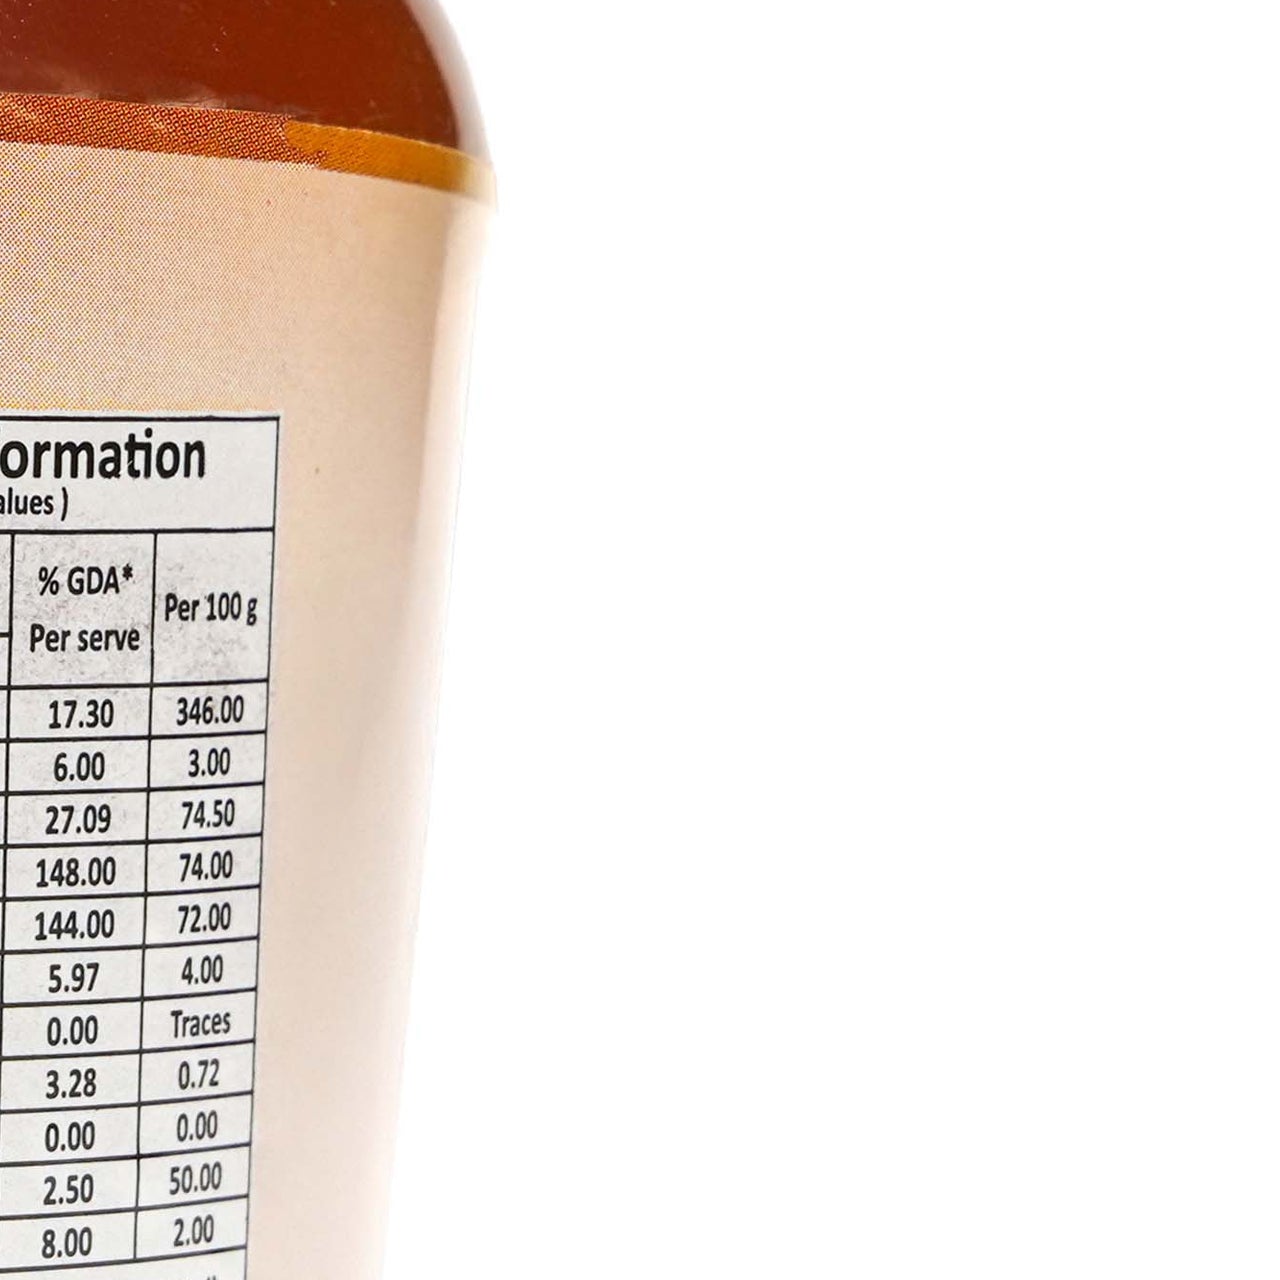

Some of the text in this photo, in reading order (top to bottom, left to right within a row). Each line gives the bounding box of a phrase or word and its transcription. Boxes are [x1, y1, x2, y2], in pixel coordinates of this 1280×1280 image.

[38, 567, 60, 595] %
[165, 592, 257, 626] Per 100 g
[30, 623, 140, 652] Per serve
[49, 699, 114, 729] 17.30
[177, 695, 244, 726] 346.00
[54, 752, 105, 782] 6.00
[189, 747, 230, 777] 3.00
[46, 804, 111, 834] 27.09
[182, 799, 235, 828] 74.50
[37, 857, 116, 888] 148.00
[180, 850, 233, 881] 74.00
[36, 909, 114, 941] 144.00
[178, 902, 231, 933] 72.00
[49, 962, 99, 993] 5.97
[181, 955, 223, 984] 4.00
[47, 1015, 98, 1046] 0.00
[171, 1010, 231, 1037] Traces
[46, 1068, 96, 1099] 3.28
[178, 1059, 219, 1090] 0.72
[45, 1121, 95, 1152] 0.00
[177, 1111, 218, 1142] 0.00
[44, 1174, 94, 1205] 2.50
[170, 1162, 222, 1195] 50.00
[42, 1227, 92, 1259] 8.00
[174, 1215, 214, 1247] 2.00
